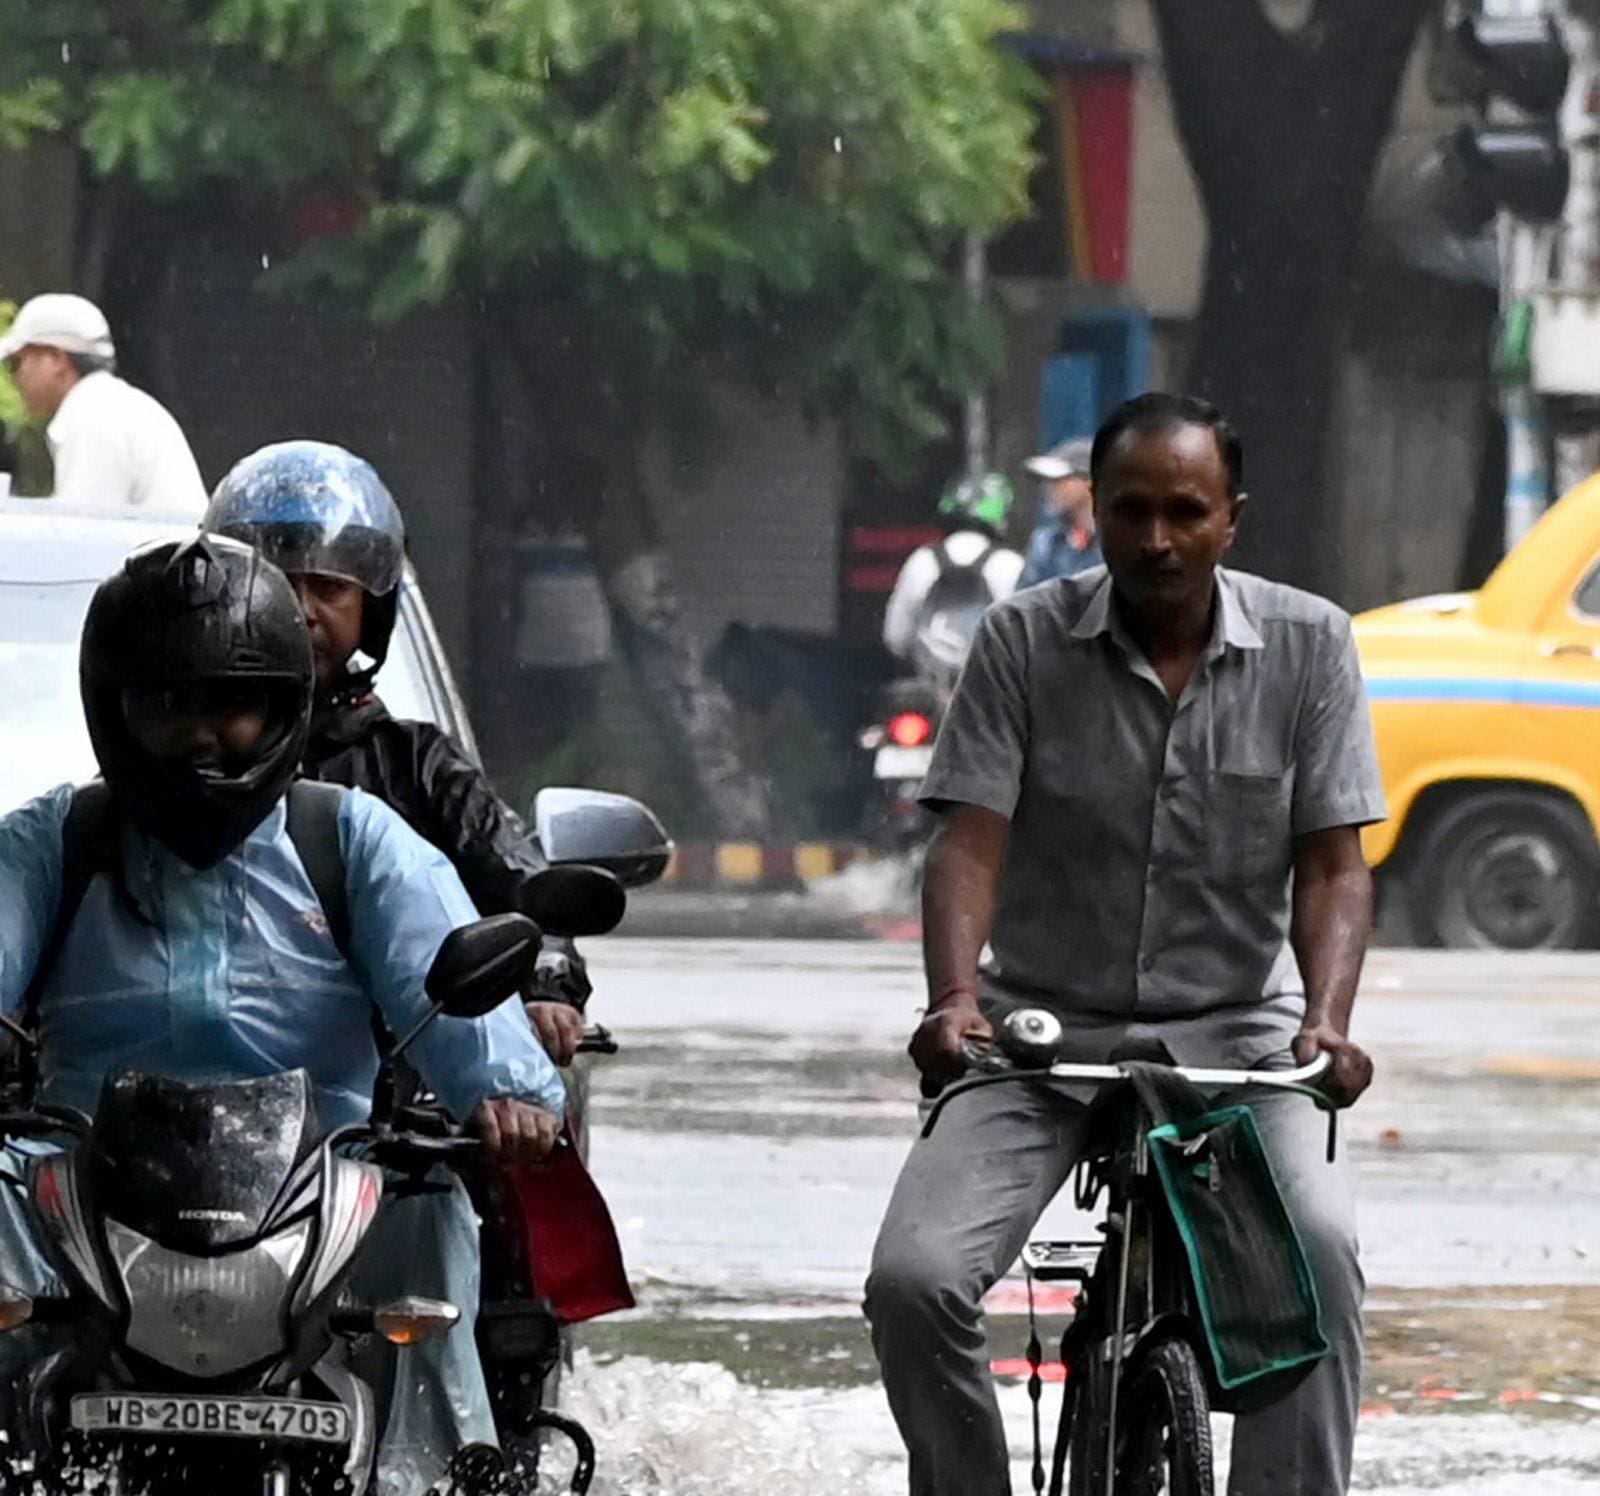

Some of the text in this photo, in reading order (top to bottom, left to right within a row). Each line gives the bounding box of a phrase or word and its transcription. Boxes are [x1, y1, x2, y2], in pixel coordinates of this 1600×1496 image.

[178, 1209, 246, 1222] HONDA
[162, 1401, 243, 1431] 20BE
[259, 1405, 339, 1437] 4703
